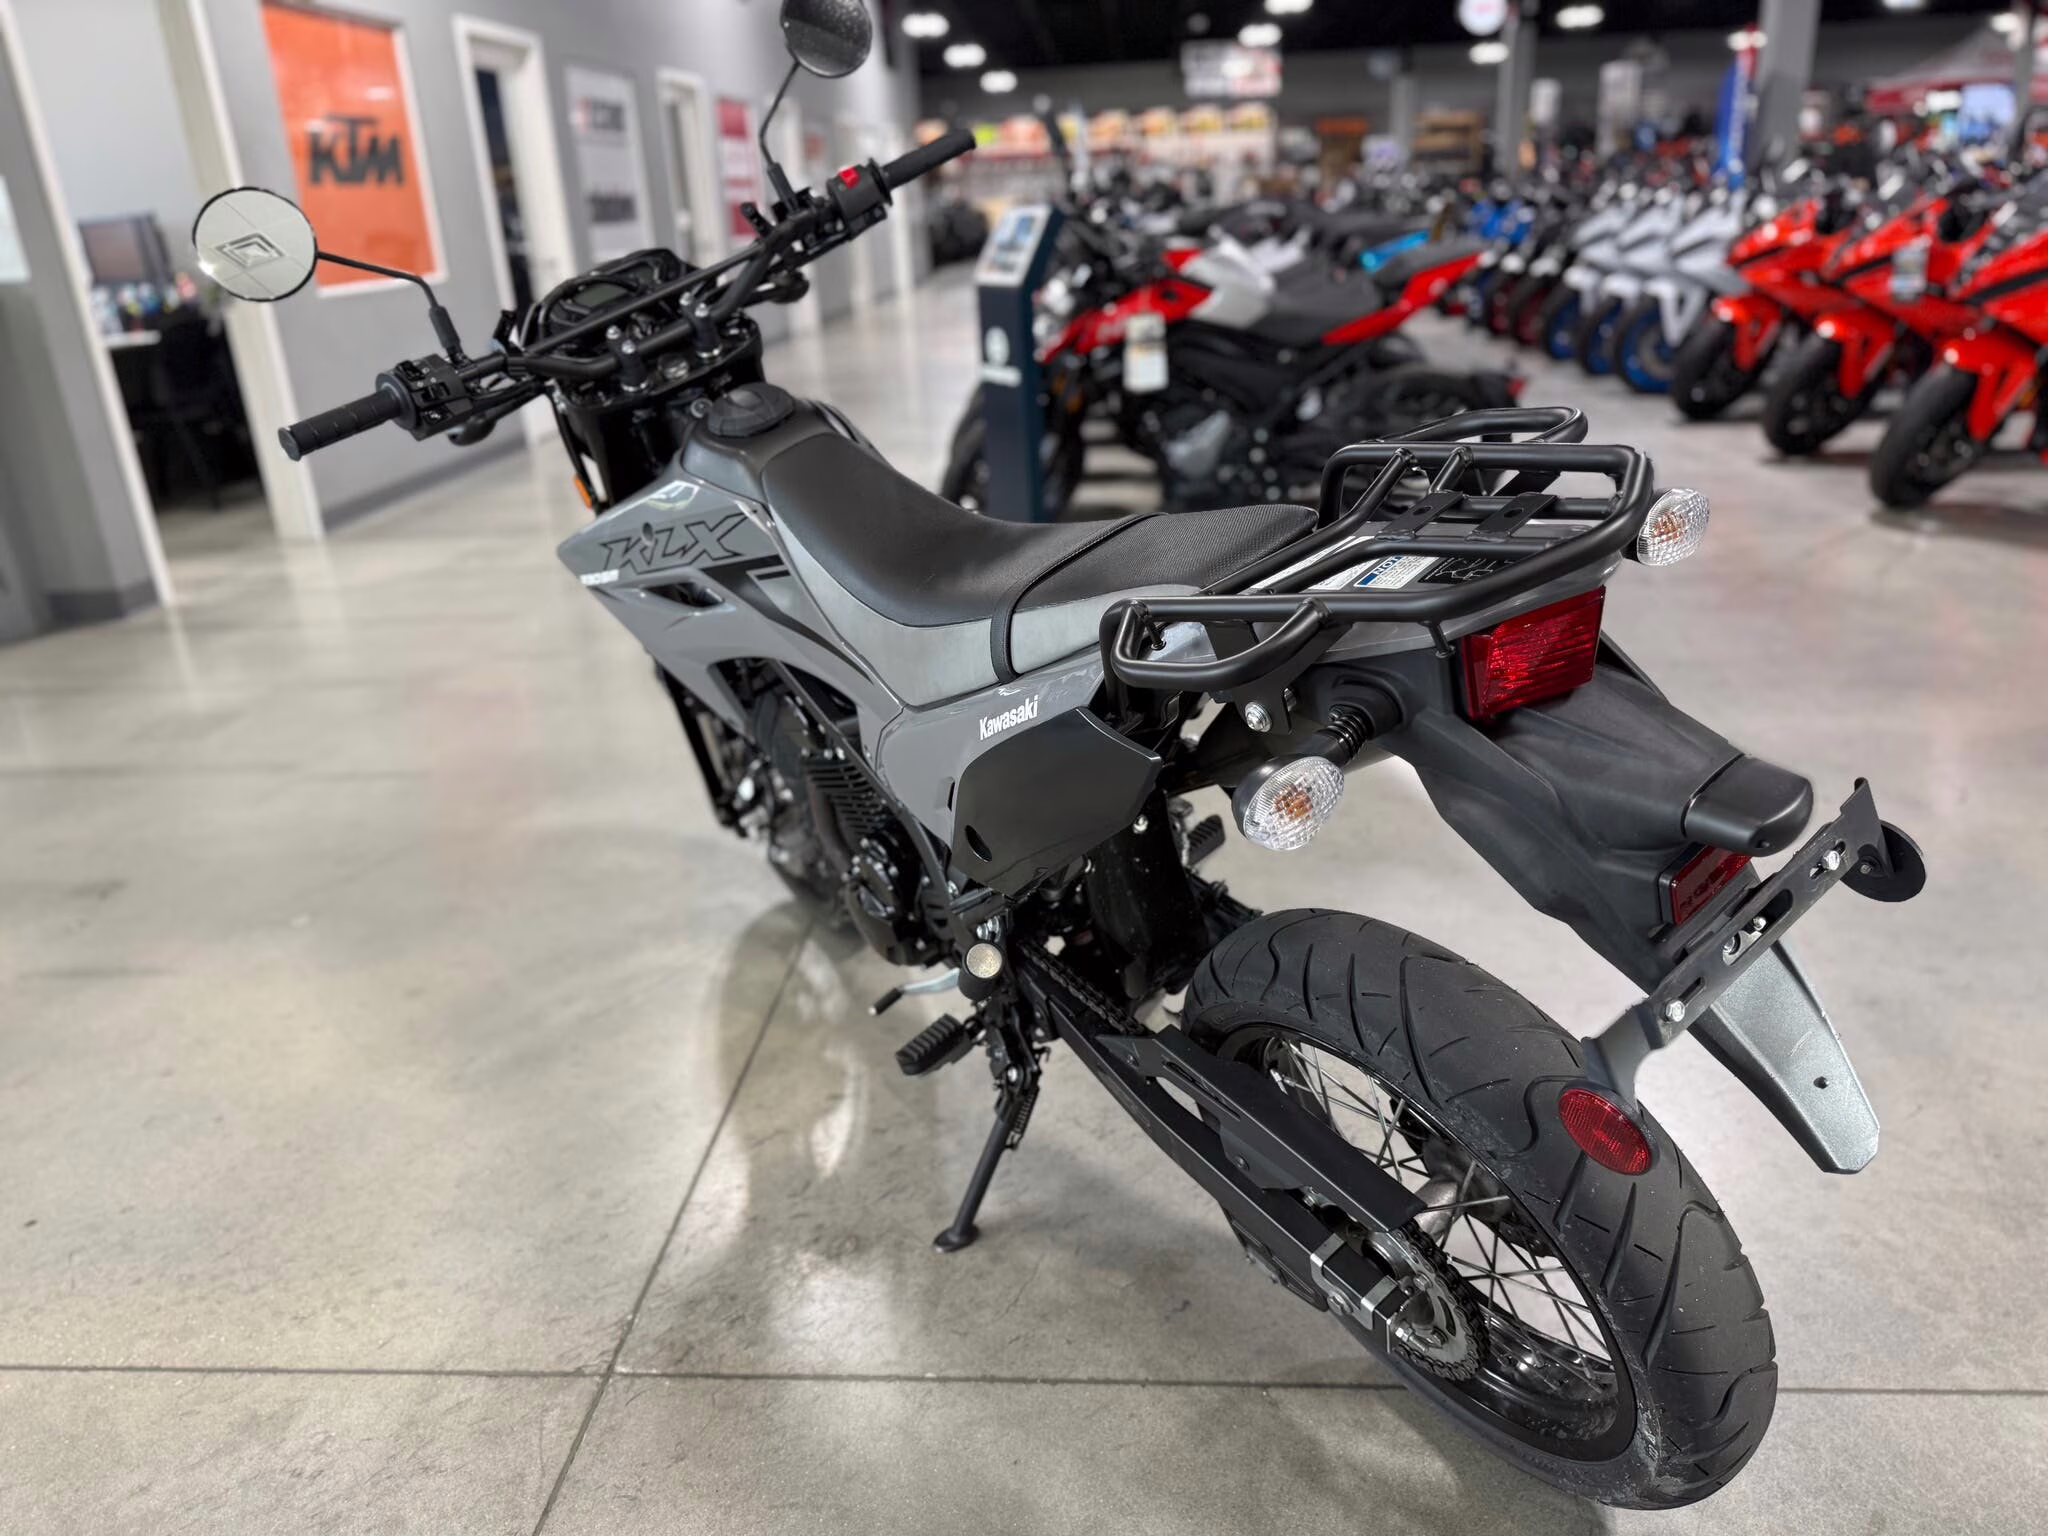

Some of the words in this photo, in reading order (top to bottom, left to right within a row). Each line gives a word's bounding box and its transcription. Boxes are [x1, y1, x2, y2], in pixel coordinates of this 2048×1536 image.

[309, 115, 404, 184] KTM
[600, 510, 756, 575] KLX
[979, 694, 1039, 741] Kawasaki
